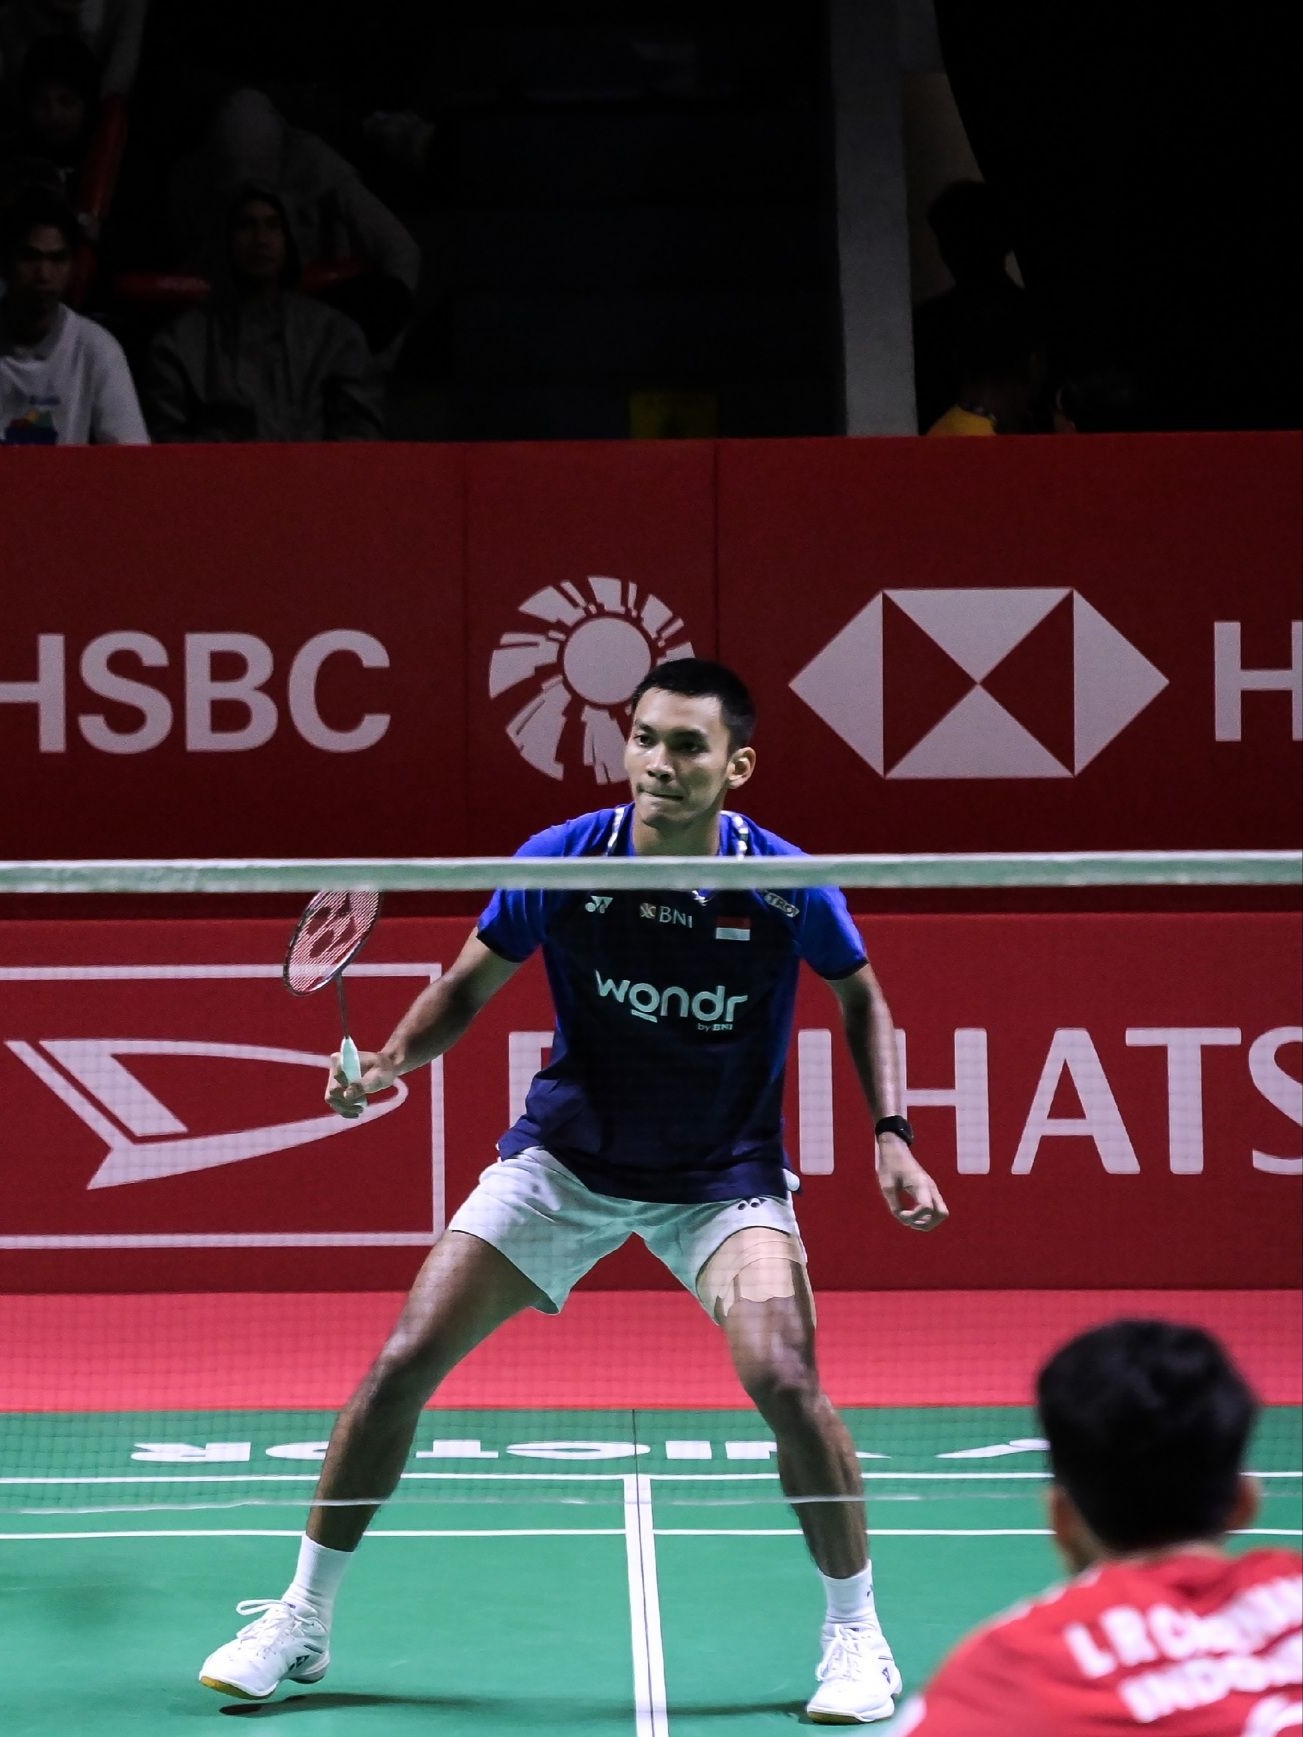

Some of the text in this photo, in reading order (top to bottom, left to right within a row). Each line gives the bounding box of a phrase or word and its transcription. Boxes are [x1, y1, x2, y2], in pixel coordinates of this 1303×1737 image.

[659, 906, 693, 928] BNI
[595, 969, 748, 1023] wondr
[697, 1023, 711, 1032] by
[509, 1026, 1303, 1176] IHATS
